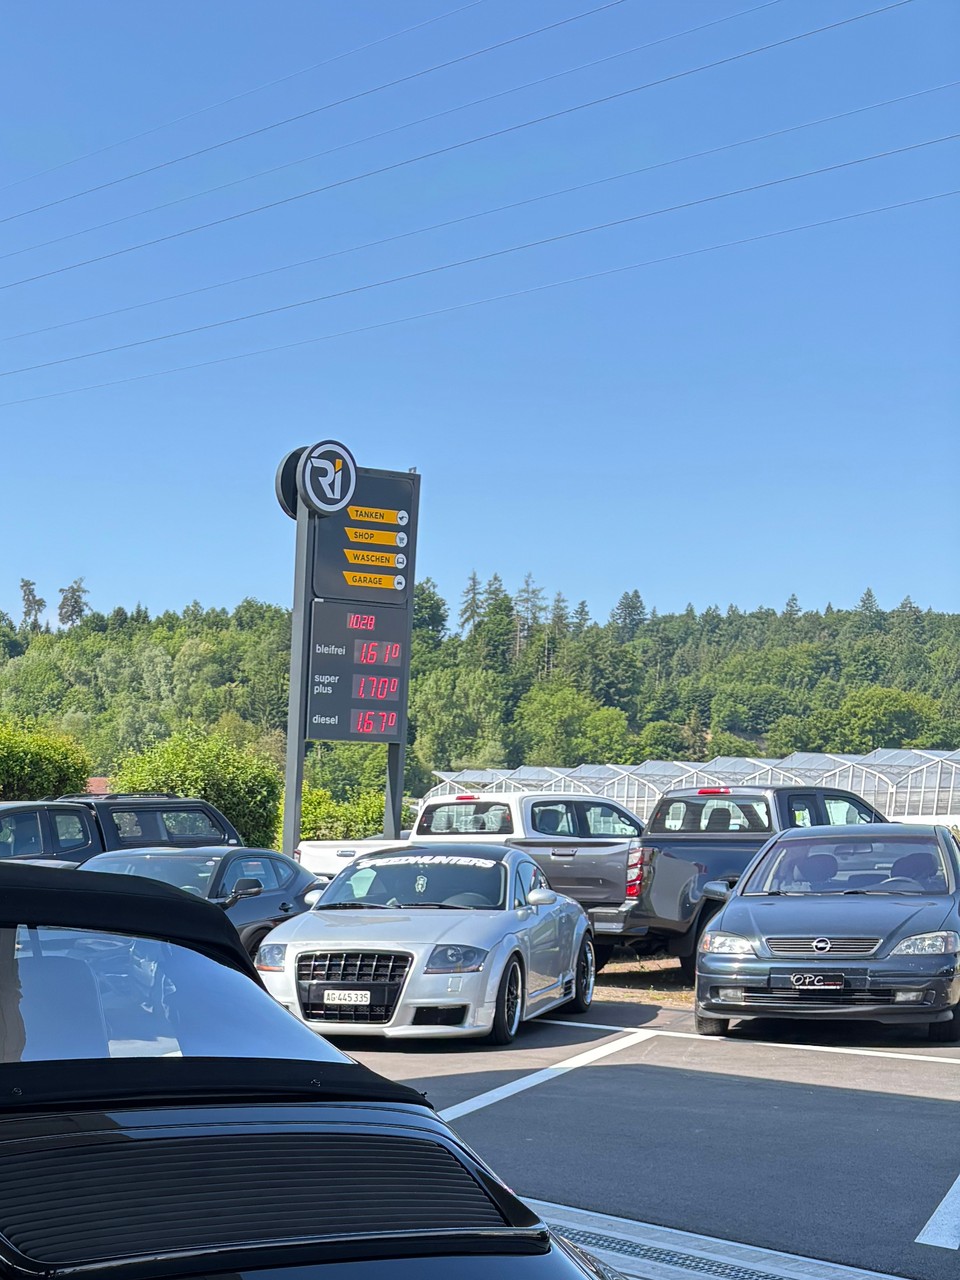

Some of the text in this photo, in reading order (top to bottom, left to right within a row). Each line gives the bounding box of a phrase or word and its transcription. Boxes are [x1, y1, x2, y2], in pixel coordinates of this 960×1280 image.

[354, 509, 385, 520] TANKEN
[353, 531, 375, 541] SHOP
[352, 553, 391, 564] WASCHEN
[351, 575, 383, 586] GARAGE
[315, 643, 346, 656] bleifrei
[314, 674, 340, 685] super
[313, 684, 333, 695] plus
[312, 714, 339, 725] diesel
[792, 974, 824, 986] OPC
